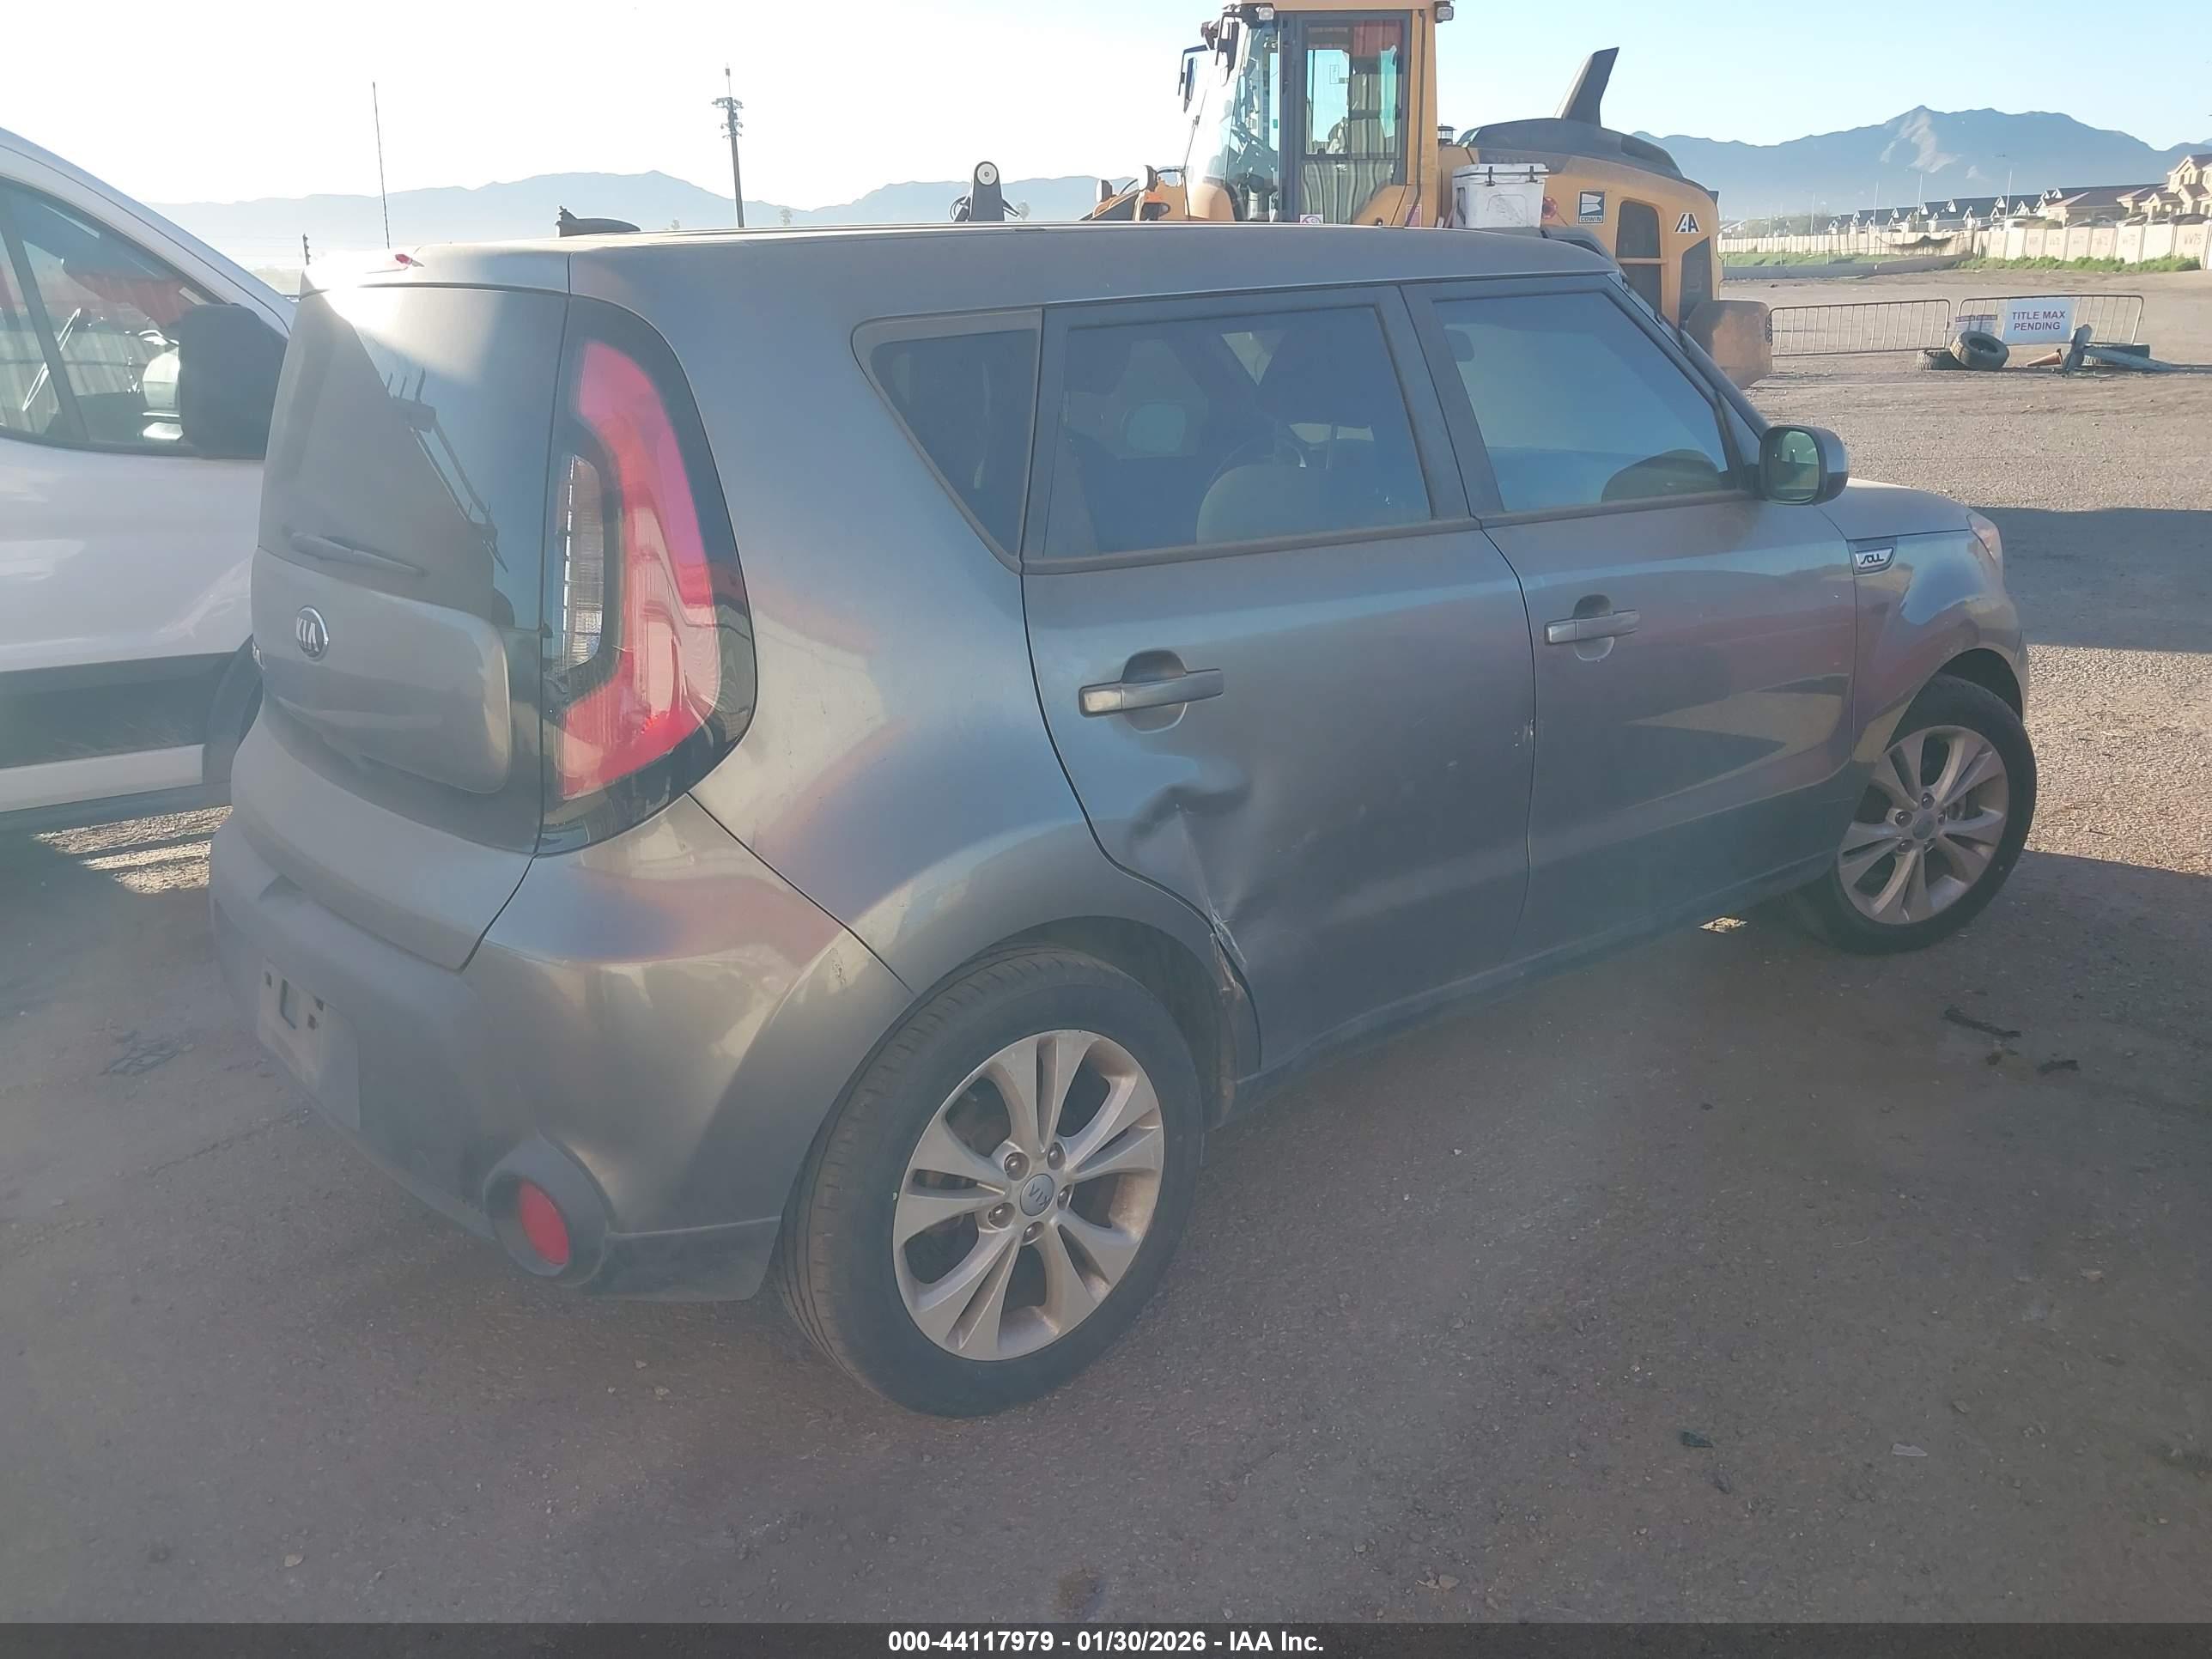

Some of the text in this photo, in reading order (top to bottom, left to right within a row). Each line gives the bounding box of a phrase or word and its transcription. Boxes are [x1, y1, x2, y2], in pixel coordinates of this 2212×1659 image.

[2012, 310, 2066, 320] TITLE MAX
[2014, 321, 2061, 331] PENDING
[295, 617, 320, 653] KIA
[1028, 1183, 1052, 1209] KIA
